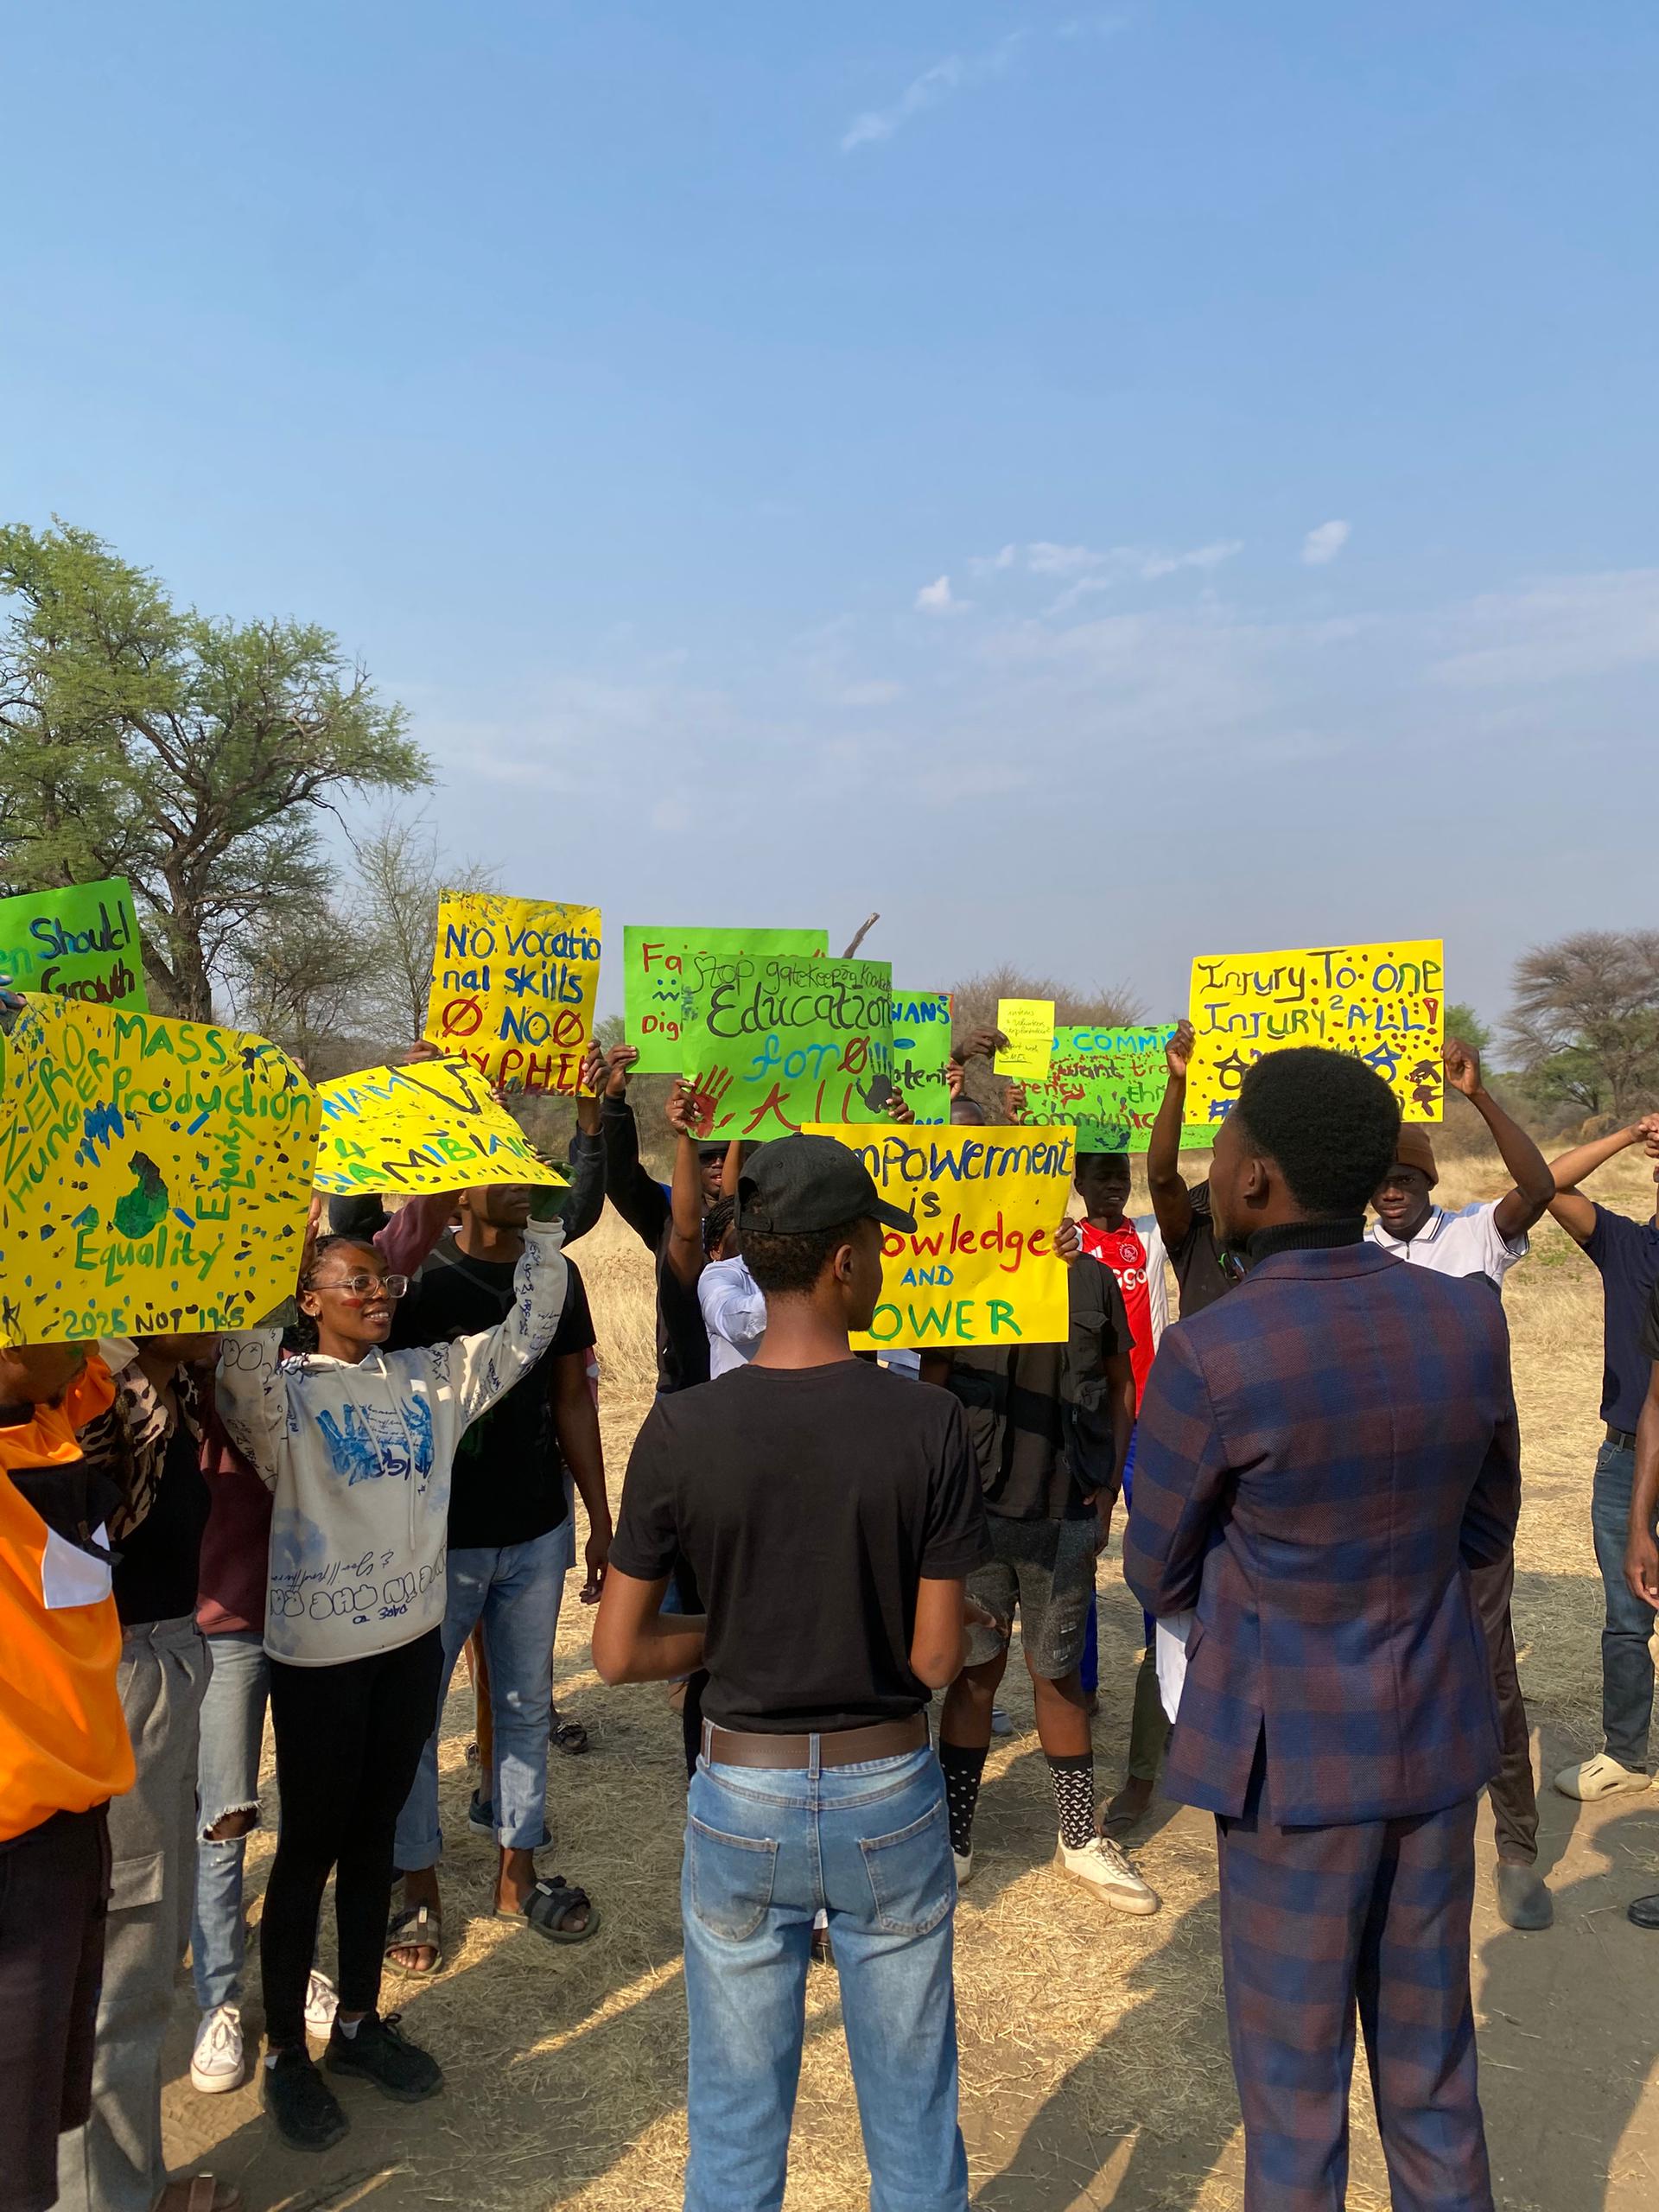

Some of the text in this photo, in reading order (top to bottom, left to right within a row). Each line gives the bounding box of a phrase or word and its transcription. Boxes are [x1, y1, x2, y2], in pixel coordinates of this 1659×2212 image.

[29, 899, 130, 959] Should
[445, 924, 495, 959] NO
[442, 965, 490, 992] nal
[1198, 960, 1305, 1003] Injury
[1306, 949, 1357, 989] To
[1329, 995, 1345, 1010] 2
[707, 982, 893, 1037] Education
[113, 1012, 226, 1065] MASS
[742, 1033, 840, 1081] for
[0, 1023, 85, 1185] ZERO
[112, 1065, 312, 1123] Production
[74, 1224, 226, 1287] Equality
[881, 1211, 1051, 1273] owledge
[900, 1264, 954, 1287] AND
[135, 1308, 183, 1333] NOT
[868, 1300, 1022, 1341] OWER
